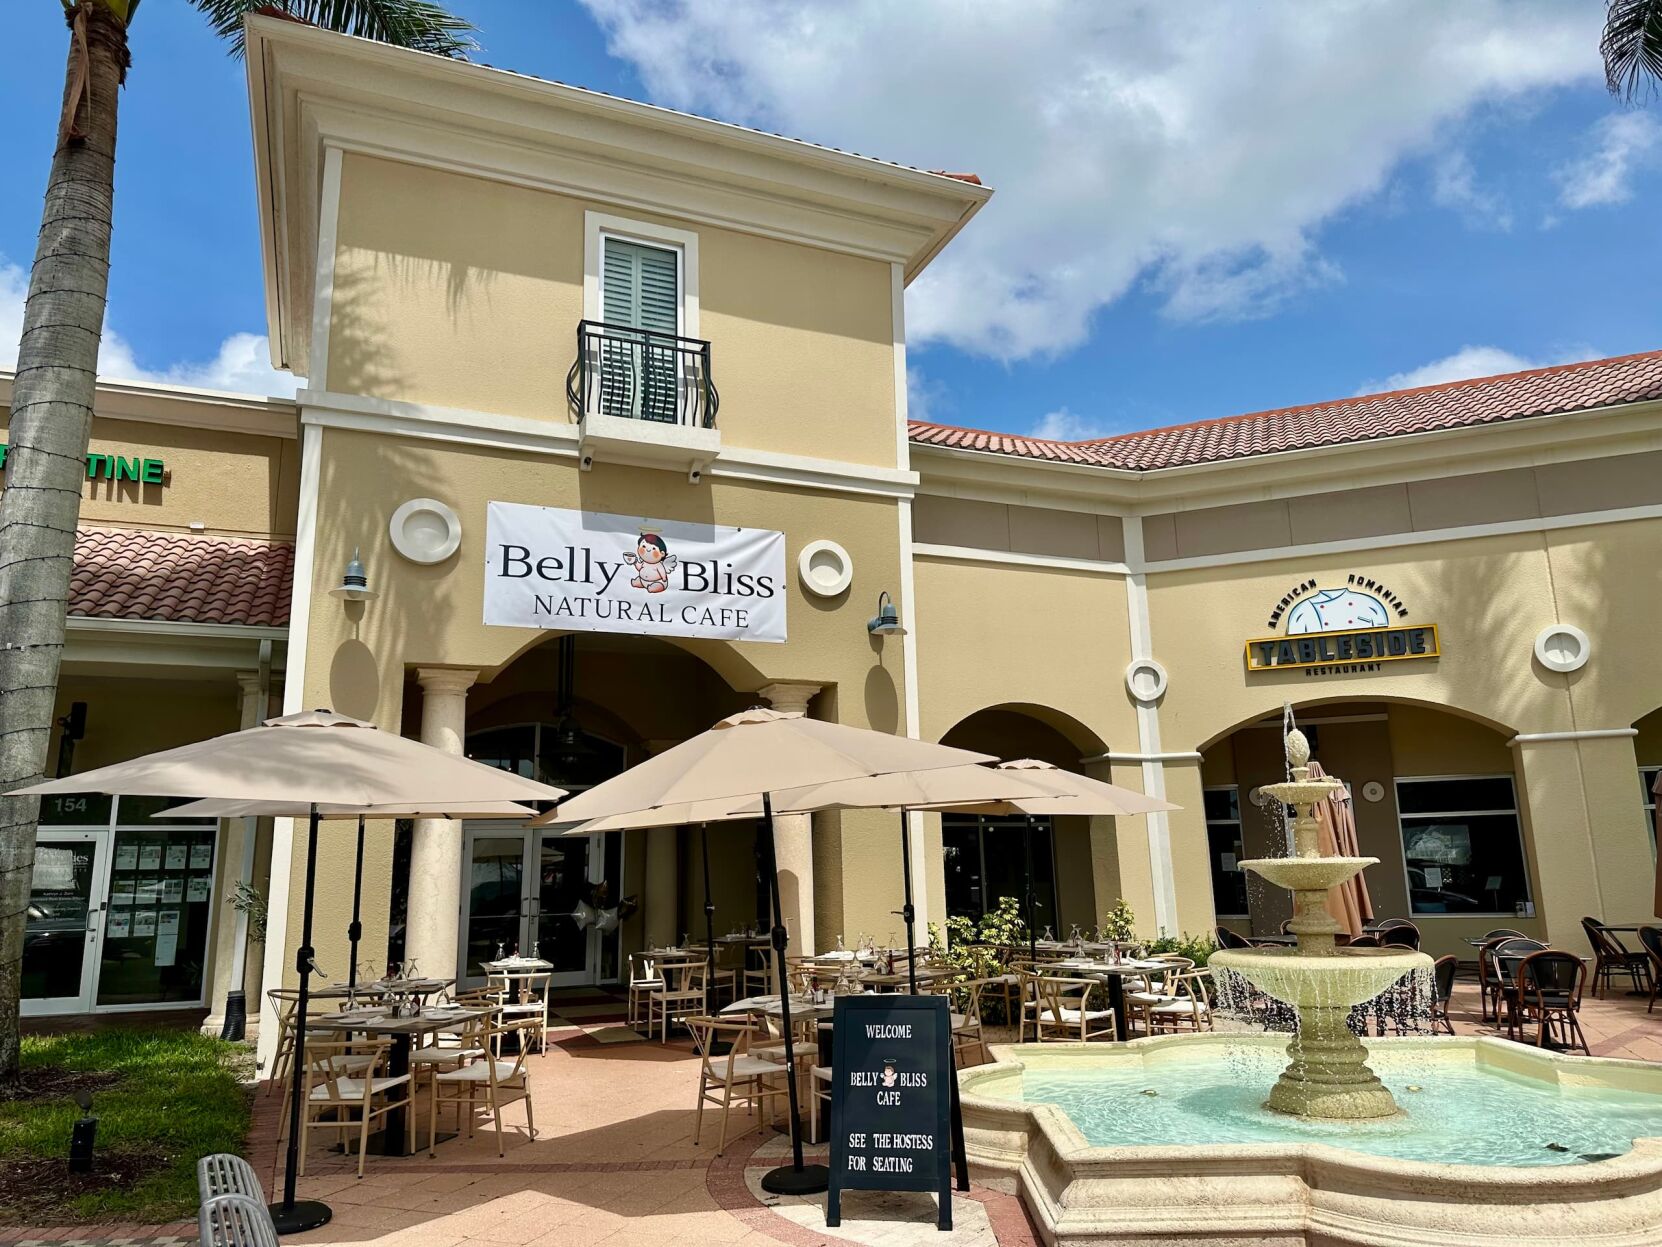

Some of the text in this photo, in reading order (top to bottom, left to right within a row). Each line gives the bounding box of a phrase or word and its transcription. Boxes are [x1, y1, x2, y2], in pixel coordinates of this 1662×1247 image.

[497, 544, 775, 599] Belly Bliss
[1268, 574, 1409, 630] AMERICAN ROMANIAN
[533, 594, 750, 629] NATURAL CAFE
[1260, 629, 1426, 666] TABLESIDE
[1305, 663, 1382, 676] RESTAURANT
[55, 798, 87, 812] 154
[865, 1024, 912, 1039] WELCOME
[850, 1071, 927, 1087] BELLY BLISS
[877, 1091, 901, 1105] CAFE
[849, 1133, 933, 1150] SEE THE HOSTESS
[848, 1155, 913, 1173] FOR SEATING
